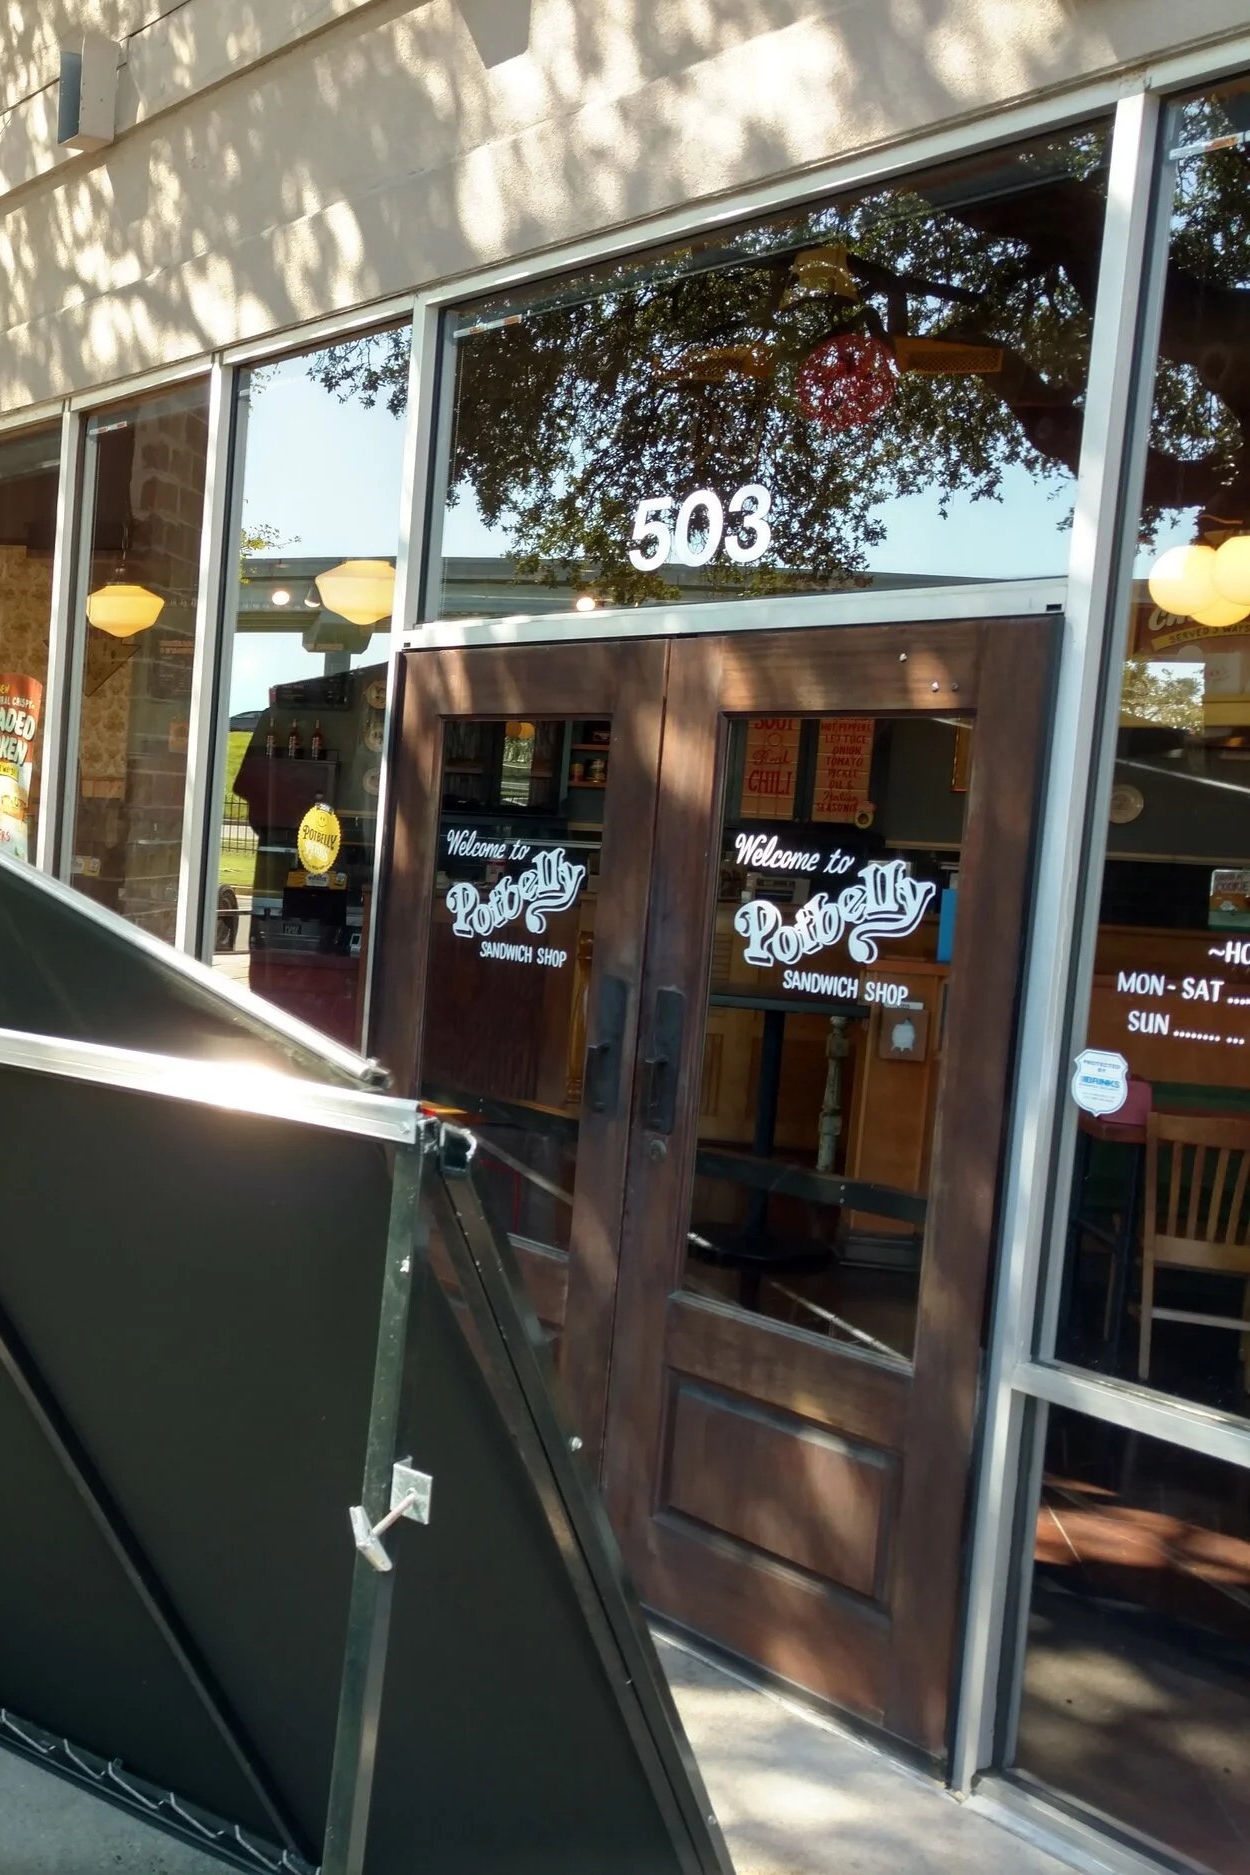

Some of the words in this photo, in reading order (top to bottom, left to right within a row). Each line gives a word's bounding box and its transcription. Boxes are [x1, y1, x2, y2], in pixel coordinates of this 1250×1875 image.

[629, 484, 771, 571] 503
[1169, 627, 1209, 643] SERVED
[825, 735, 868, 744] LETTUCE
[833, 746, 861, 755] ONION
[826, 757, 864, 767] TOMATO
[748, 770, 791, 795] CHILI
[302, 825, 338, 851] POTBELLY
[447, 829, 506, 858] Welcome
[509, 839, 531, 861] to
[735, 833, 820, 871] Welcome
[823, 848, 855, 874] to
[446, 848, 586, 938] Potbelly
[734, 860, 936, 967] Potbelly
[479, 941, 533, 963] SANDWICH
[536, 947, 567, 968] SHOP
[782, 970, 859, 999] SANDWICH
[864, 981, 909, 1005] SHOP
[1127, 1010, 1170, 1036] SUN
[1083, 1060, 1121, 1070] PROTECTED
